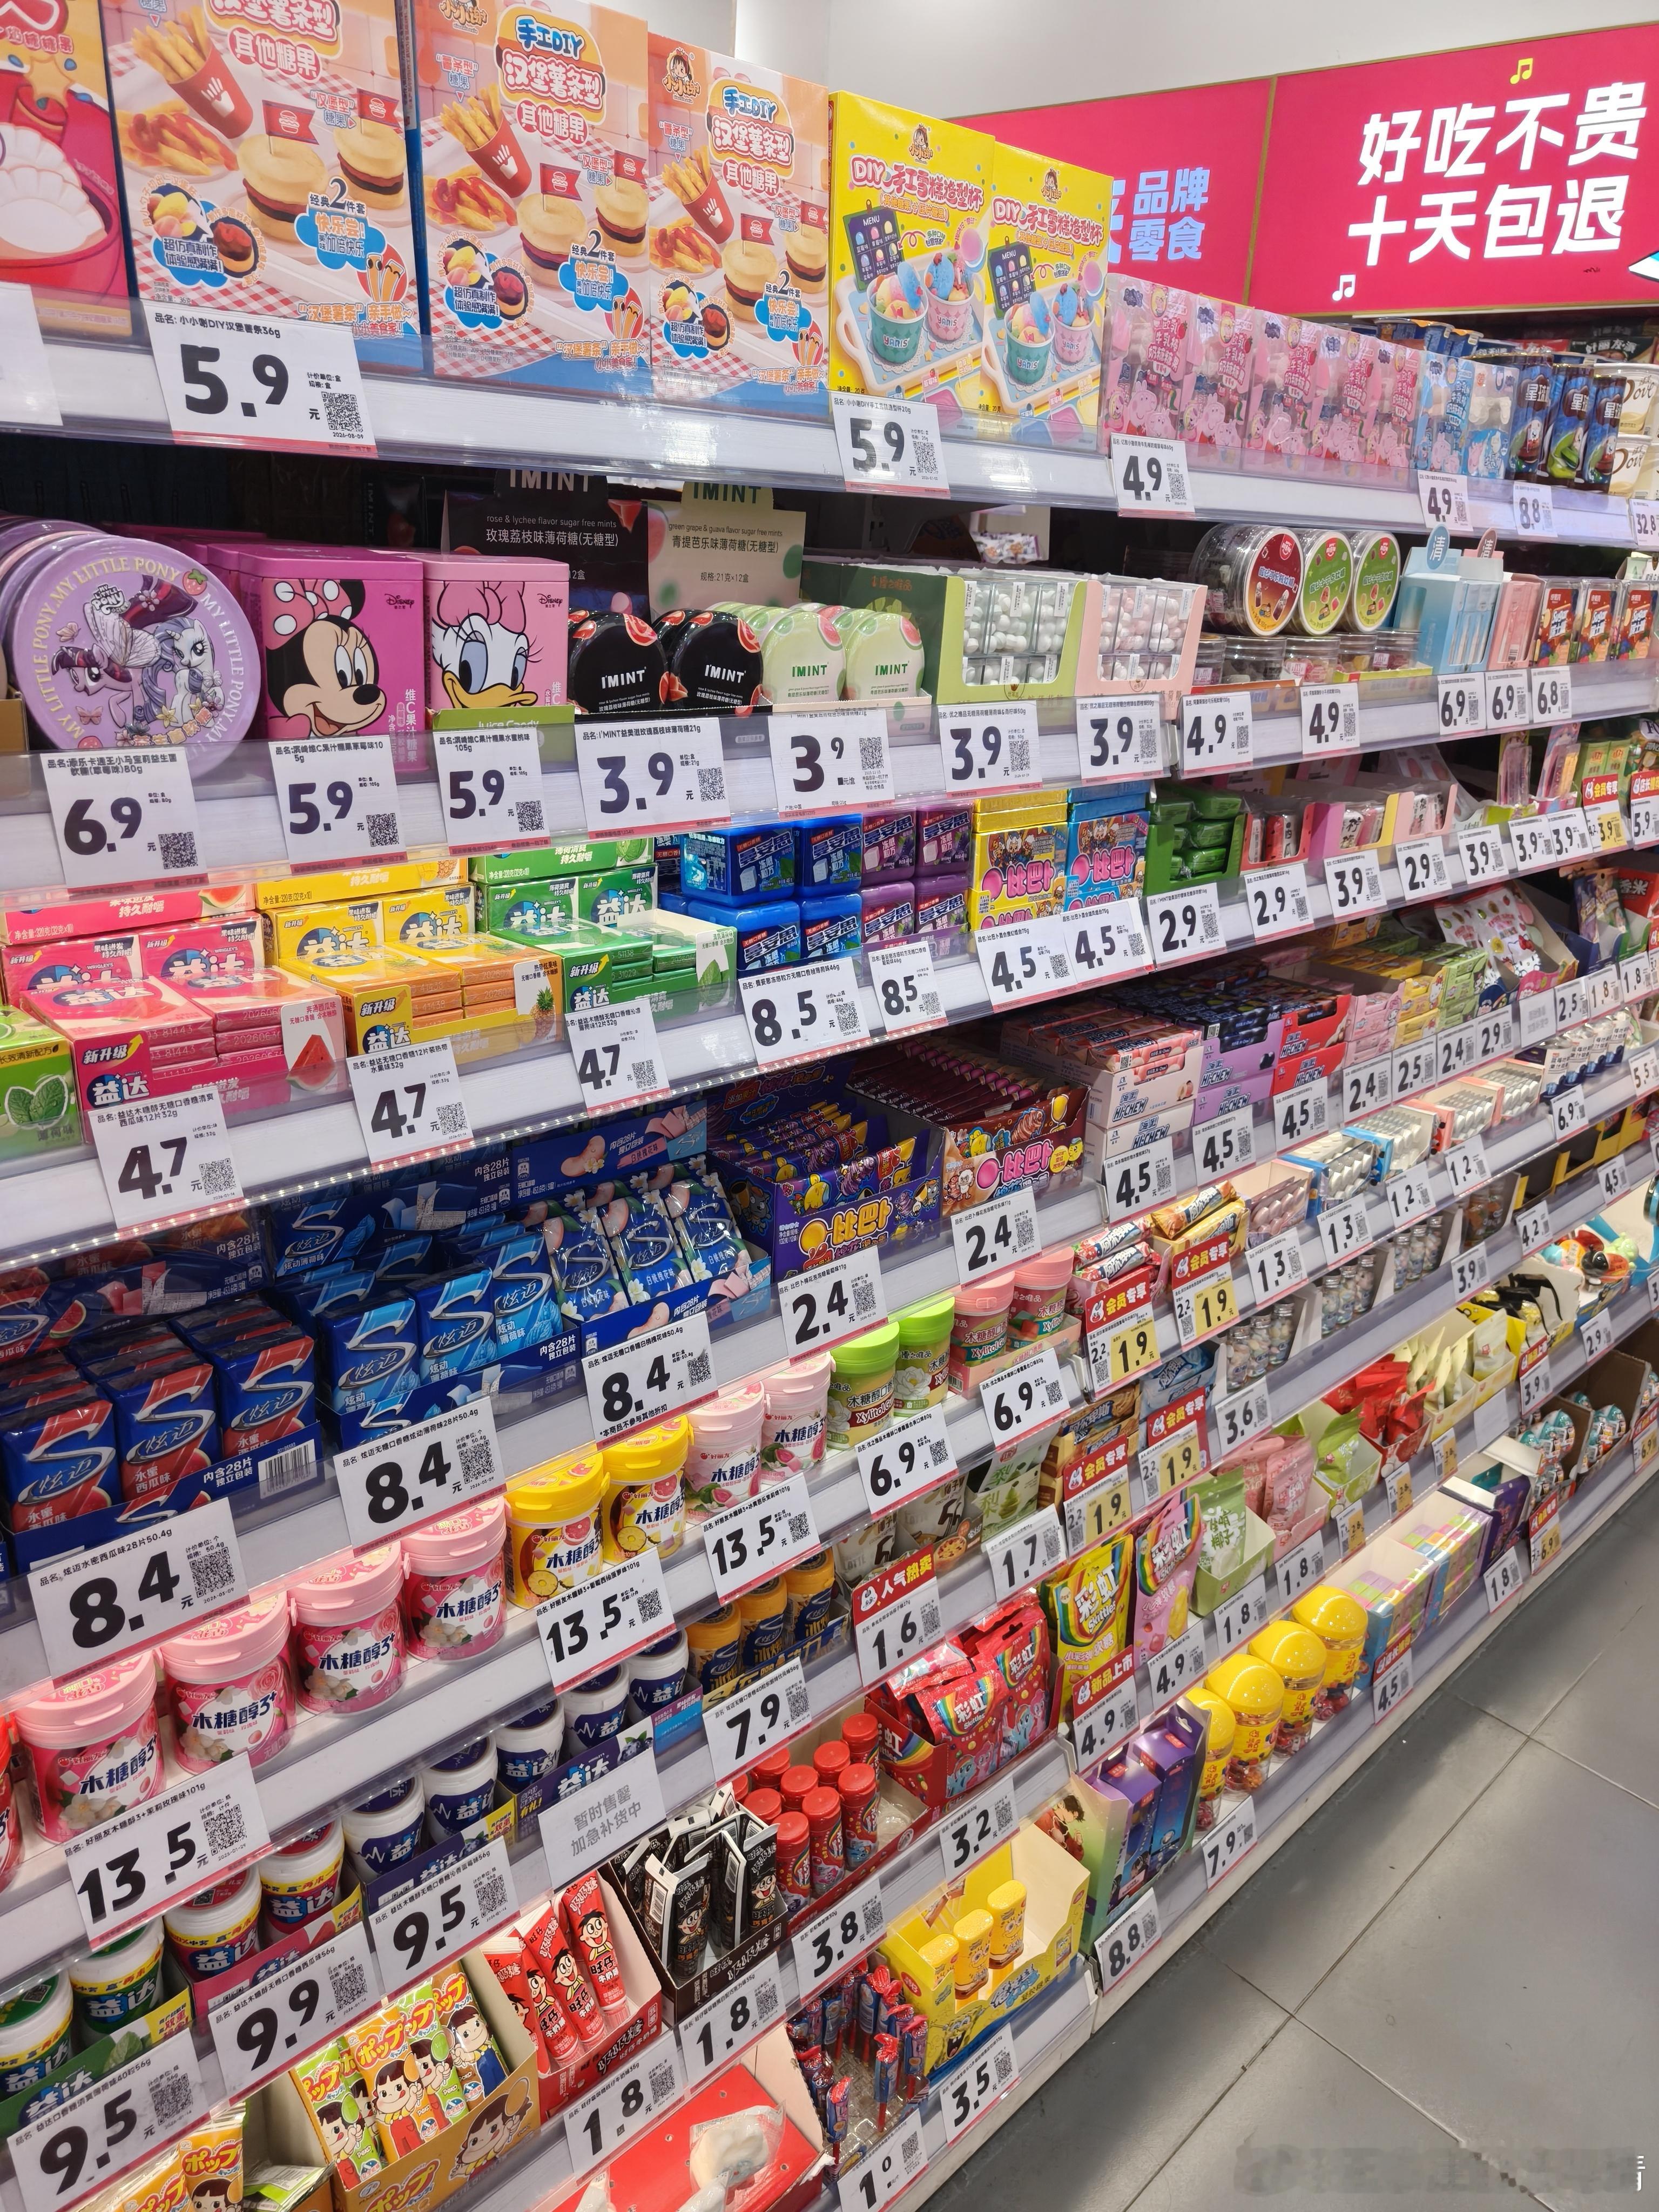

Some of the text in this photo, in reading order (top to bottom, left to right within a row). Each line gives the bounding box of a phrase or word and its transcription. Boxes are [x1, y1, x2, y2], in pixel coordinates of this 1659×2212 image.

[232, 30, 320, 79] 其他糖果
[516, 18, 584, 59] 手工DIY
[502, 49, 603, 111] 汉堡薯条型
[722, 88, 778, 122] 手工DIY
[1357, 82, 1647, 186] 好吃不贵
[1135, 167, 1211, 213] 品牌
[862, 215, 880, 227] MENU
[1129, 217, 1204, 261] 零食
[1348, 176, 1630, 266] 十天包退
[163, 237, 217, 257] 超仿真制作
[884, 334, 911, 349] YARIS
[936, 315, 957, 328] YARIS
[180, 344, 288, 417] 5.9
[850, 418, 904, 472] 5.9
[1123, 456, 1162, 501] 4.9
[487, 515, 617, 528] rose & lychee flavor sugar free mints
[1428, 487, 1451, 522] 4.9
[486, 528, 619, 548] 玫瑰荔枝味薄荷糖(无糖型)
[669, 523, 685, 532] green
[686, 524, 703, 534] grape
[726, 526, 741, 534] flavor
[671, 535, 779, 554] 青提芭乐味薄荷糖(无糖型)
[1441, 690, 1465, 726] 6.9
[1493, 685, 1514, 720] 6.9
[1538, 681, 1557, 714] 6.8
[1090, 717, 1132, 766] 3.9
[1187, 714, 1226, 756] 4.9
[1310, 702, 1339, 743] 4.9
[950, 726, 1001, 780] 3.9
[450, 770, 504, 819] 5.9
[597, 752, 673, 813] 3.9
[64, 798, 141, 855] 6.9
[289, 781, 353, 834] 5.9
[1466, 841, 1488, 875] 3.9
[1518, 832, 1537, 861] 3.9
[1553, 827, 1573, 855] 3.9
[1006, 860, 1055, 897] 比巴卜
[1092, 846, 1135, 881] 比巴卜
[1405, 854, 1429, 891] 2.9
[1254, 887, 1285, 926] 2.9
[1334, 868, 1363, 907] 3.9
[1075, 925, 1115, 969] 4.5
[1159, 905, 1196, 952] 2.9
[992, 946, 1036, 993] 4.5
[882, 975, 917, 1015] 8.5
[1556, 993, 1577, 1023] 2.5
[752, 990, 817, 1046] 8.5
[83, 1048, 131, 1064] 新升级
[1442, 1038, 1464, 1074] 2.4
[1482, 1023, 1500, 1056] 2.9
[576, 1044, 620, 1090] 4.7
[1398, 1055, 1421, 1092] 2.5
[91, 1070, 150, 1108] 益达
[1350, 1073, 1375, 1112] 2.4
[371, 1083, 426, 1138] 4.7
[1283, 1099, 1309, 1139] 4.5
[1559, 1103, 1574, 1130] 6.9
[118, 1137, 187, 1199] 4.7
[1203, 1129, 1233, 1172] 4.5
[1450, 1156, 1471, 1185] 1.2
[1116, 1161, 1150, 1208] 4.5
[1392, 1185, 1414, 1217] 1.2
[832, 1198, 892, 1244] 比巴卜
[1328, 1217, 1353, 1253] 1.3
[966, 1215, 1011, 1271] 2.4
[1189, 1242, 1228, 1272] 会员专享
[1258, 1250, 1285, 1292] 1.3
[1458, 1260, 1475, 1293] 3.9
[793, 1280, 848, 1345] 2.4
[1106, 1279, 1147, 1316] 会员专享
[1202, 1290, 1226, 1327] 1.9
[1119, 1332, 1147, 1373] 1.9
[603, 1355, 670, 1422] 8.4
[994, 1382, 1033, 1431] 6.9
[1225, 1401, 1252, 1444] 3.6
[203, 1457, 253, 1483] 内含28片
[216, 1467, 253, 1487] 独立包装
[366, 1441, 451, 1523] 8.4
[871, 1442, 914, 1496] 6.9
[1167, 1447, 1191, 1485] 1.9
[1094, 1493, 1121, 1535] 1.9
[712, 1521, 774, 1575] 13.5
[1003, 1534, 1036, 1588] 1.7
[881, 1561, 933, 1599] 人气热卖
[1076, 1562, 1116, 1622] 彩虹
[1284, 1557, 1308, 1595] 1.8
[1492, 1568, 1509, 1602] 1.8
[69, 1550, 180, 1649] 8.4
[547, 1594, 621, 1662] 13.5
[873, 1611, 916, 1670] 1.6
[1224, 1603, 1250, 1643] 1.8
[1090, 1654, 1132, 1687] 新品上市
[1157, 1654, 1184, 1694] 4.9
[1378, 1677, 1398, 1713] 4.5
[726, 1694, 779, 1759] 7.9
[1081, 1710, 1115, 1755] 4.9
[573, 1783, 631, 1832] 暂时售罄
[570, 1802, 643, 1857] 加急补货中
[952, 1810, 990, 1867] 3.2
[77, 1820, 196, 1924] 13.5
[1208, 1831, 1238, 1879] 7.9
[394, 1885, 465, 1970] 9.5
[812, 1911, 858, 1978] 3.8
[1109, 1924, 1143, 1979] 8.8
[236, 1979, 320, 2071] 9.9
[697, 1997, 750, 2066] 1.8
[952, 2061, 989, 2127] 3.5
[583, 2080, 643, 2155] 1.8
[40, 2089, 137, 2196] 9.5
